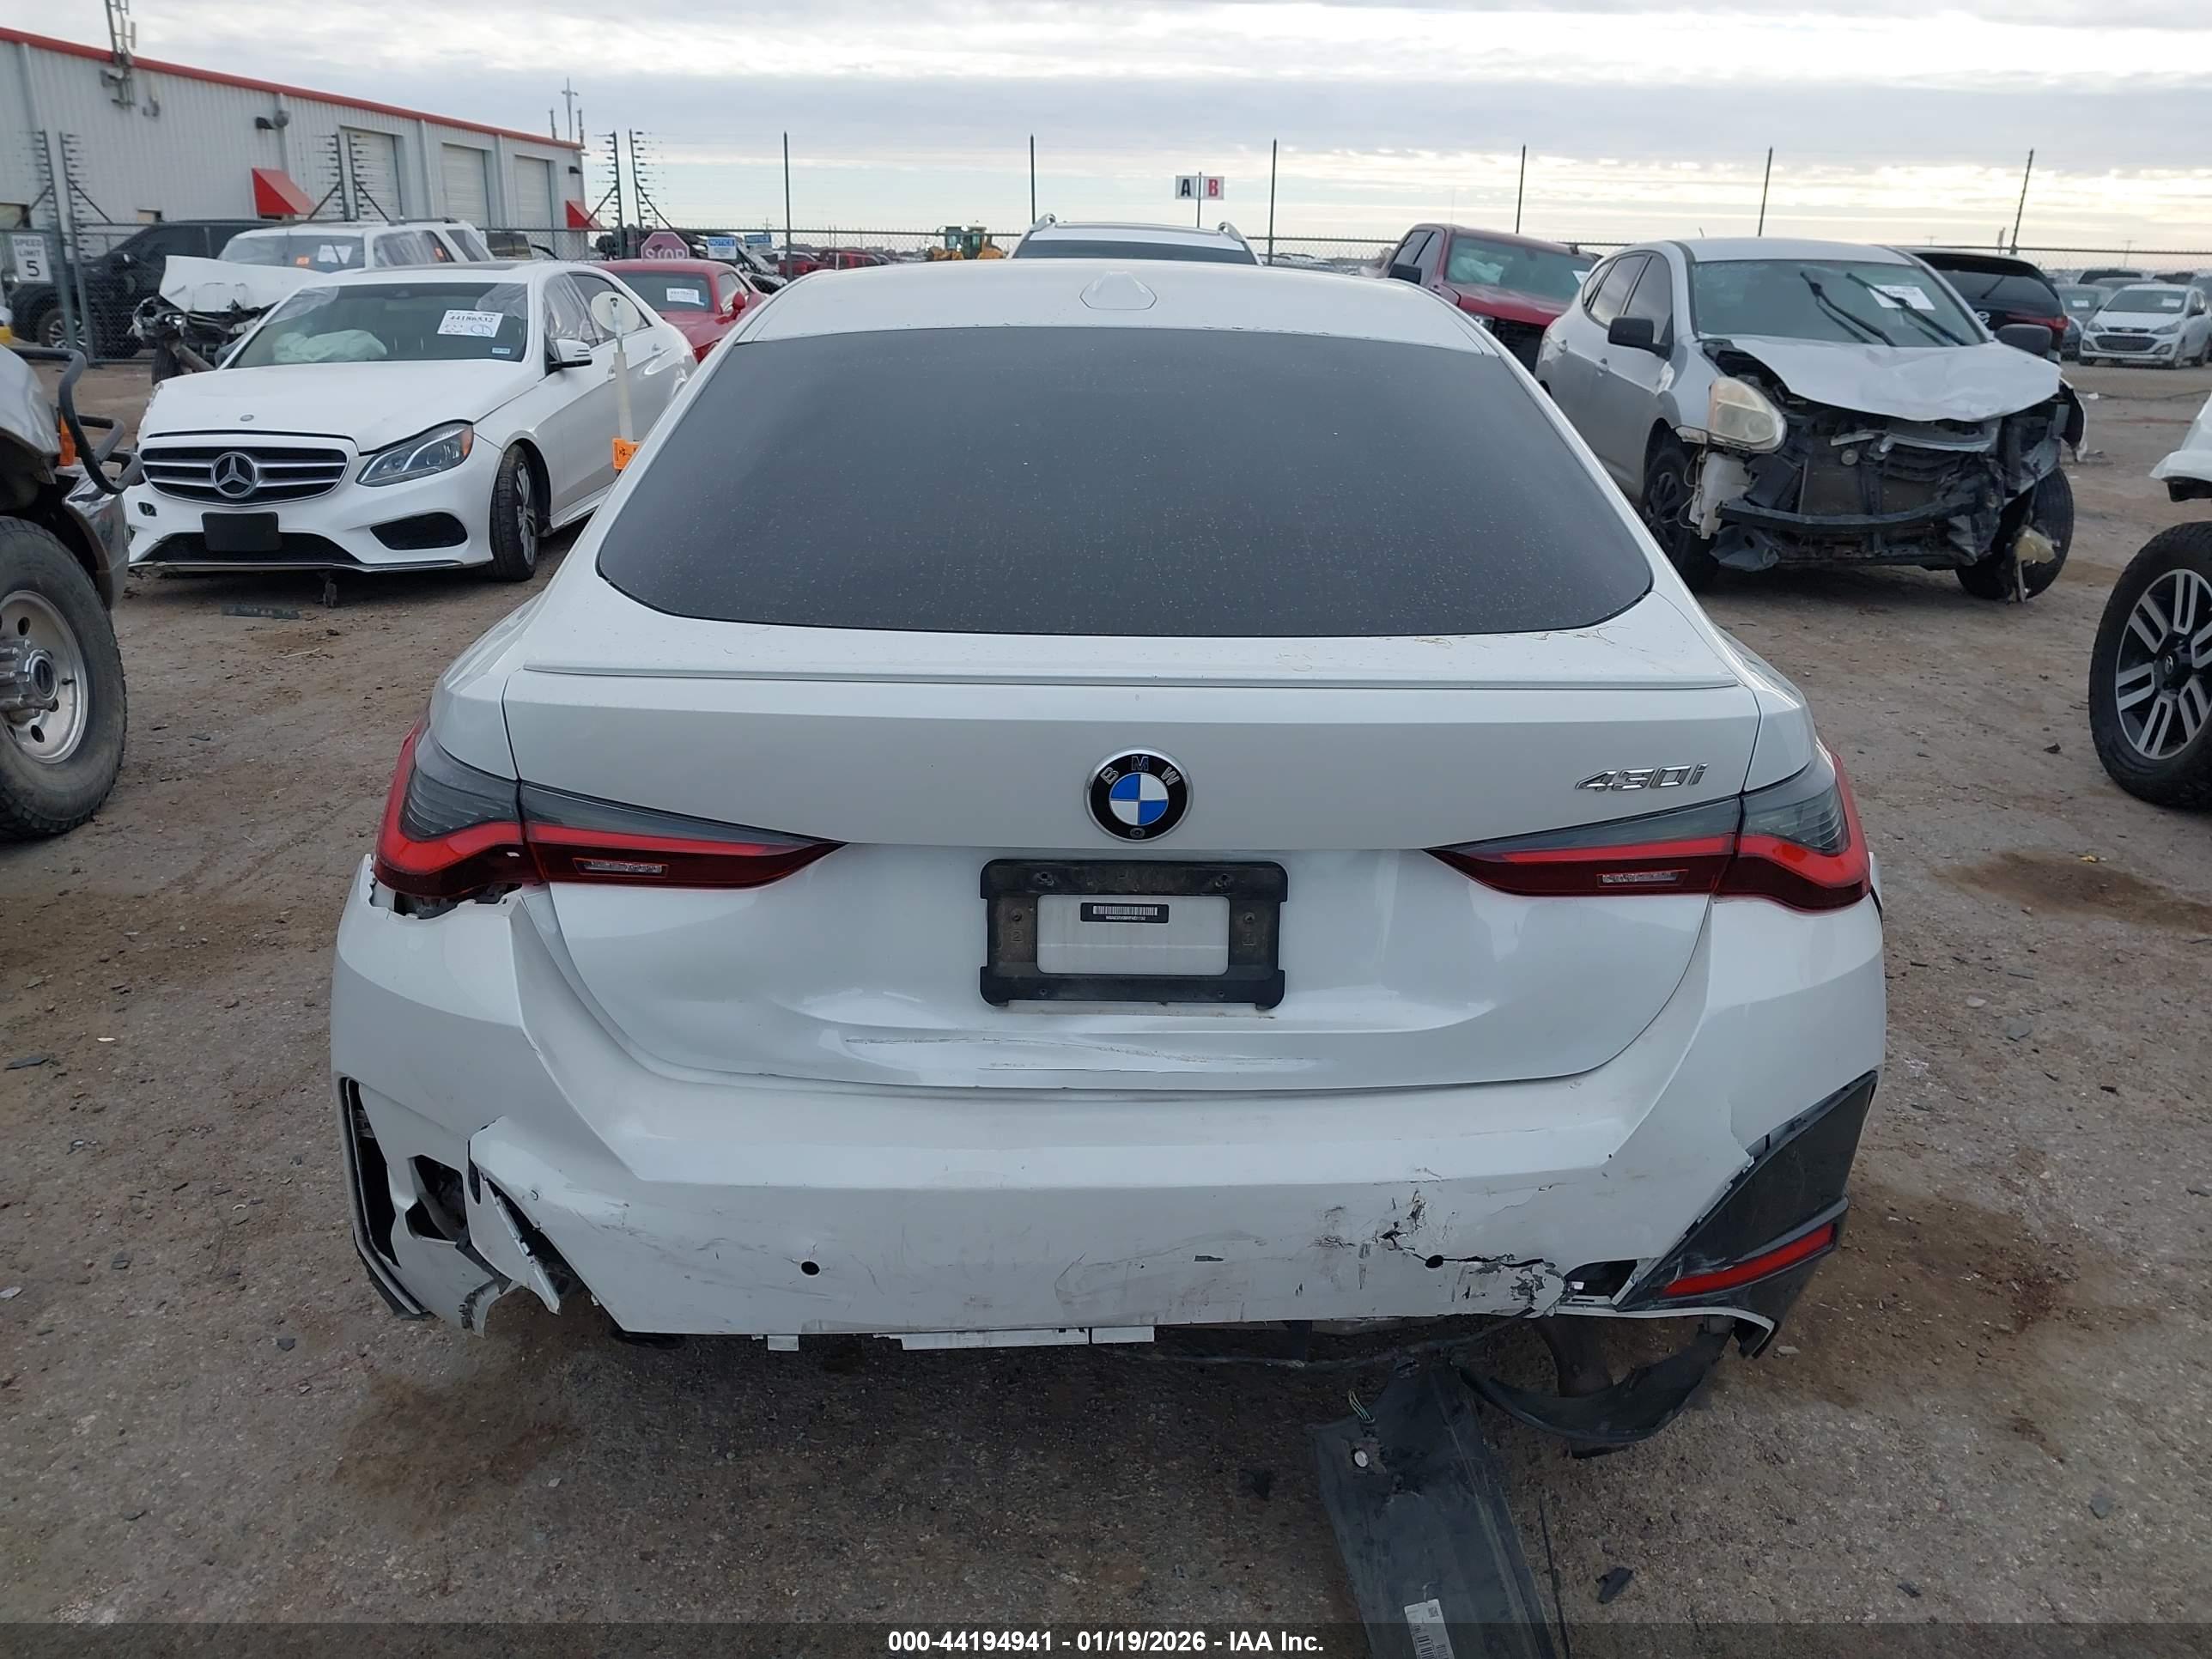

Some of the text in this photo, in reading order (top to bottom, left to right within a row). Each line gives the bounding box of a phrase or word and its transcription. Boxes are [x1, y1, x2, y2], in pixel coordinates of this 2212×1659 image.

[1181, 179, 1218, 197] A B
[27, 260, 40, 276] 5
[1100, 756, 1181, 786] BMW
[1575, 763, 1709, 792] 430i
